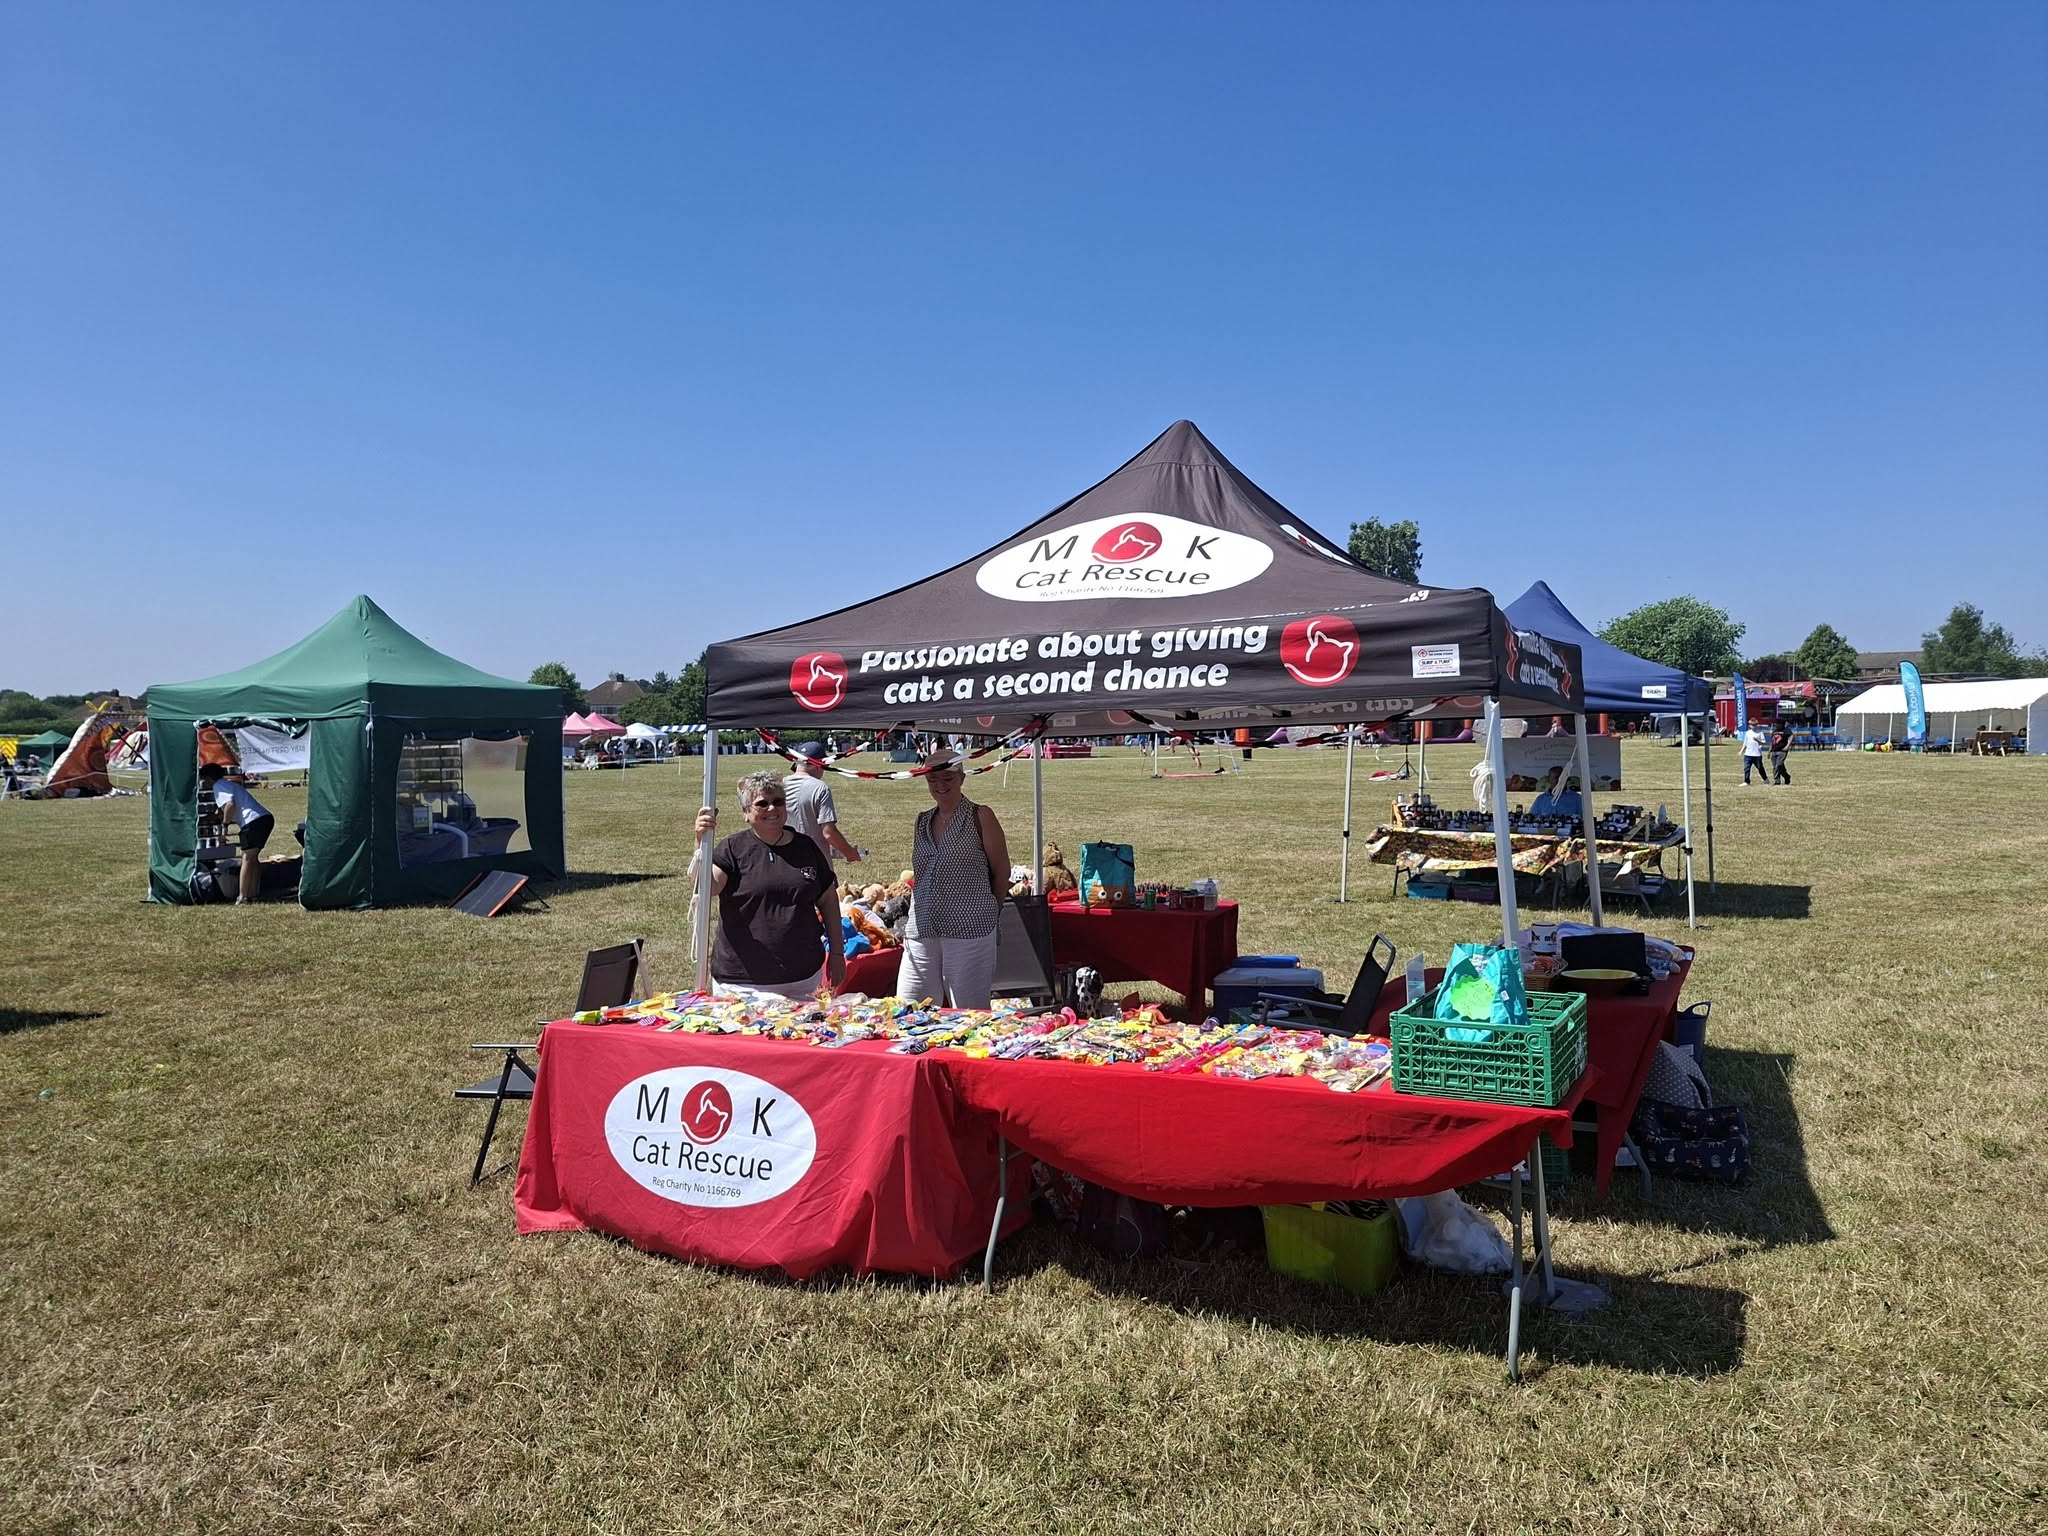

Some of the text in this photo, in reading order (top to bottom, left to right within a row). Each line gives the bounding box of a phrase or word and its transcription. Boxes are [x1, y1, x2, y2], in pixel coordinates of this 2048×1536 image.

[1028, 535, 1221, 563] M K
[1016, 564, 1210, 589] Cat Rescue
[859, 624, 1269, 673] Passionate about giving
[883, 660, 1229, 705] cats a second chance
[1907, 682, 1920, 727] WELCOME
[636, 1083, 777, 1137] M K
[632, 1135, 773, 1181] Cat Rescue
[652, 1176, 742, 1198] Reg Charity No 1166769
